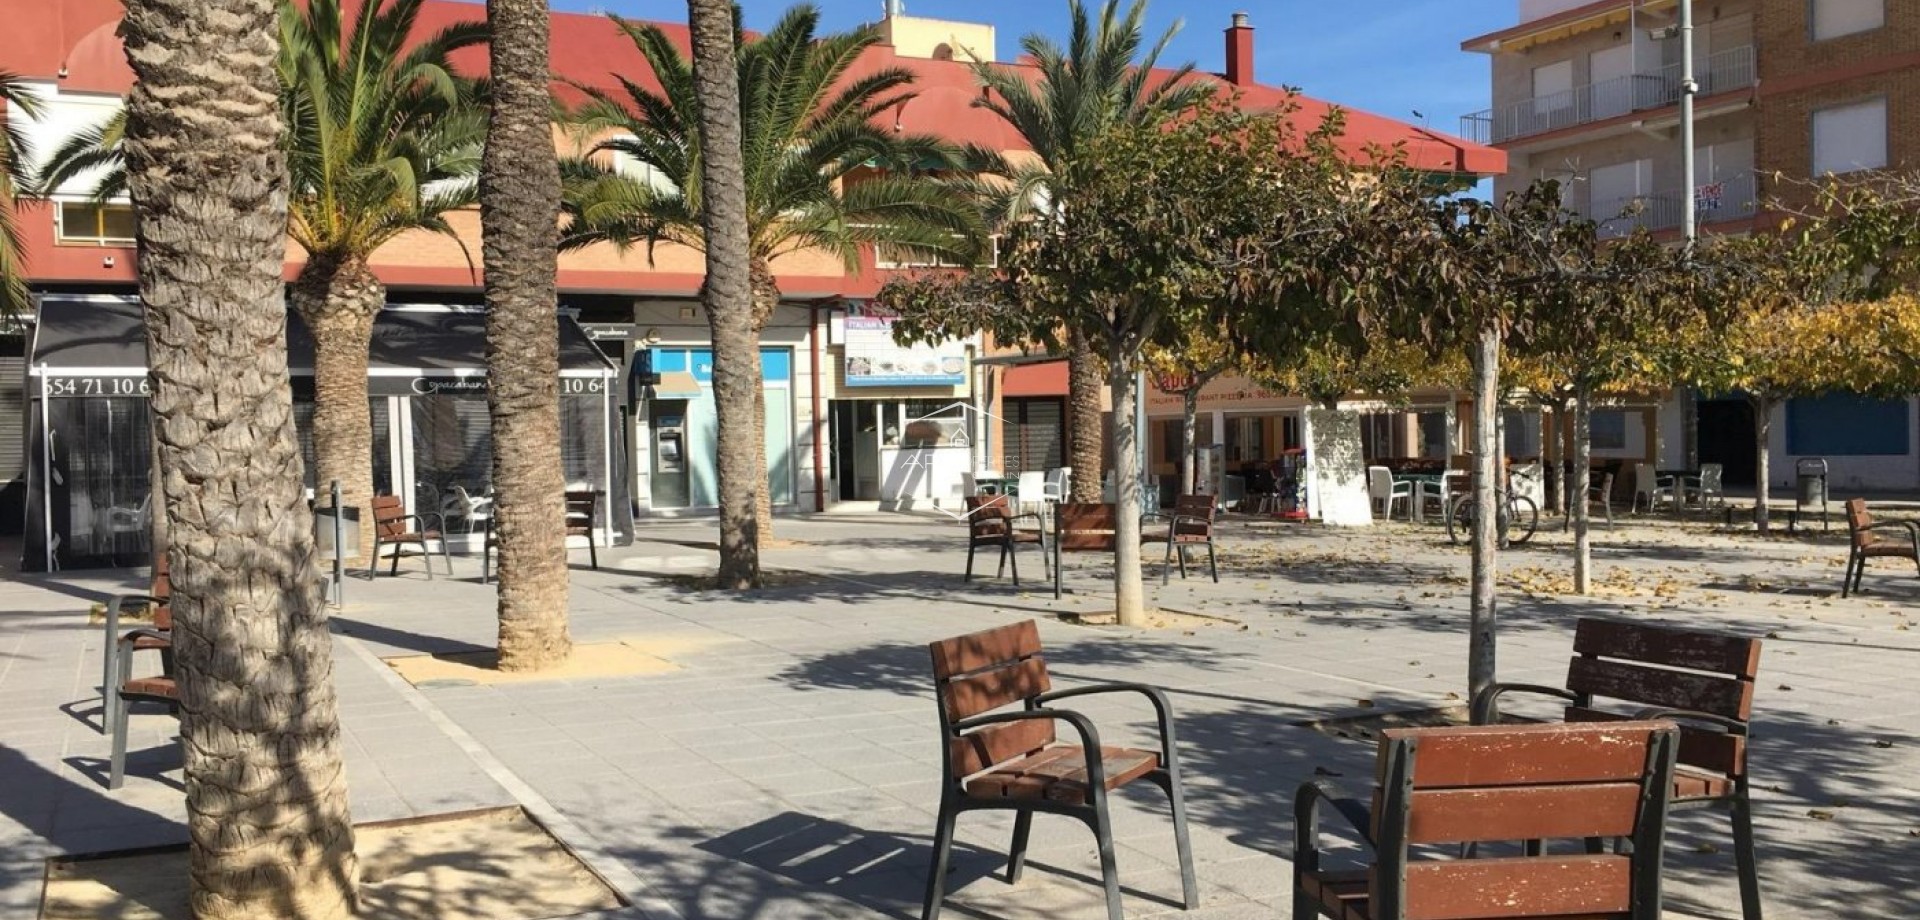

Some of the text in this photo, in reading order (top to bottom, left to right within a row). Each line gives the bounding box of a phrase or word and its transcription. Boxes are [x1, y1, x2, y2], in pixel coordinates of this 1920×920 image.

[81, 378, 103, 394] 71
[112, 378, 134, 394] 10
[139, 378, 151, 395] 6
[563, 378, 584, 394] 10
